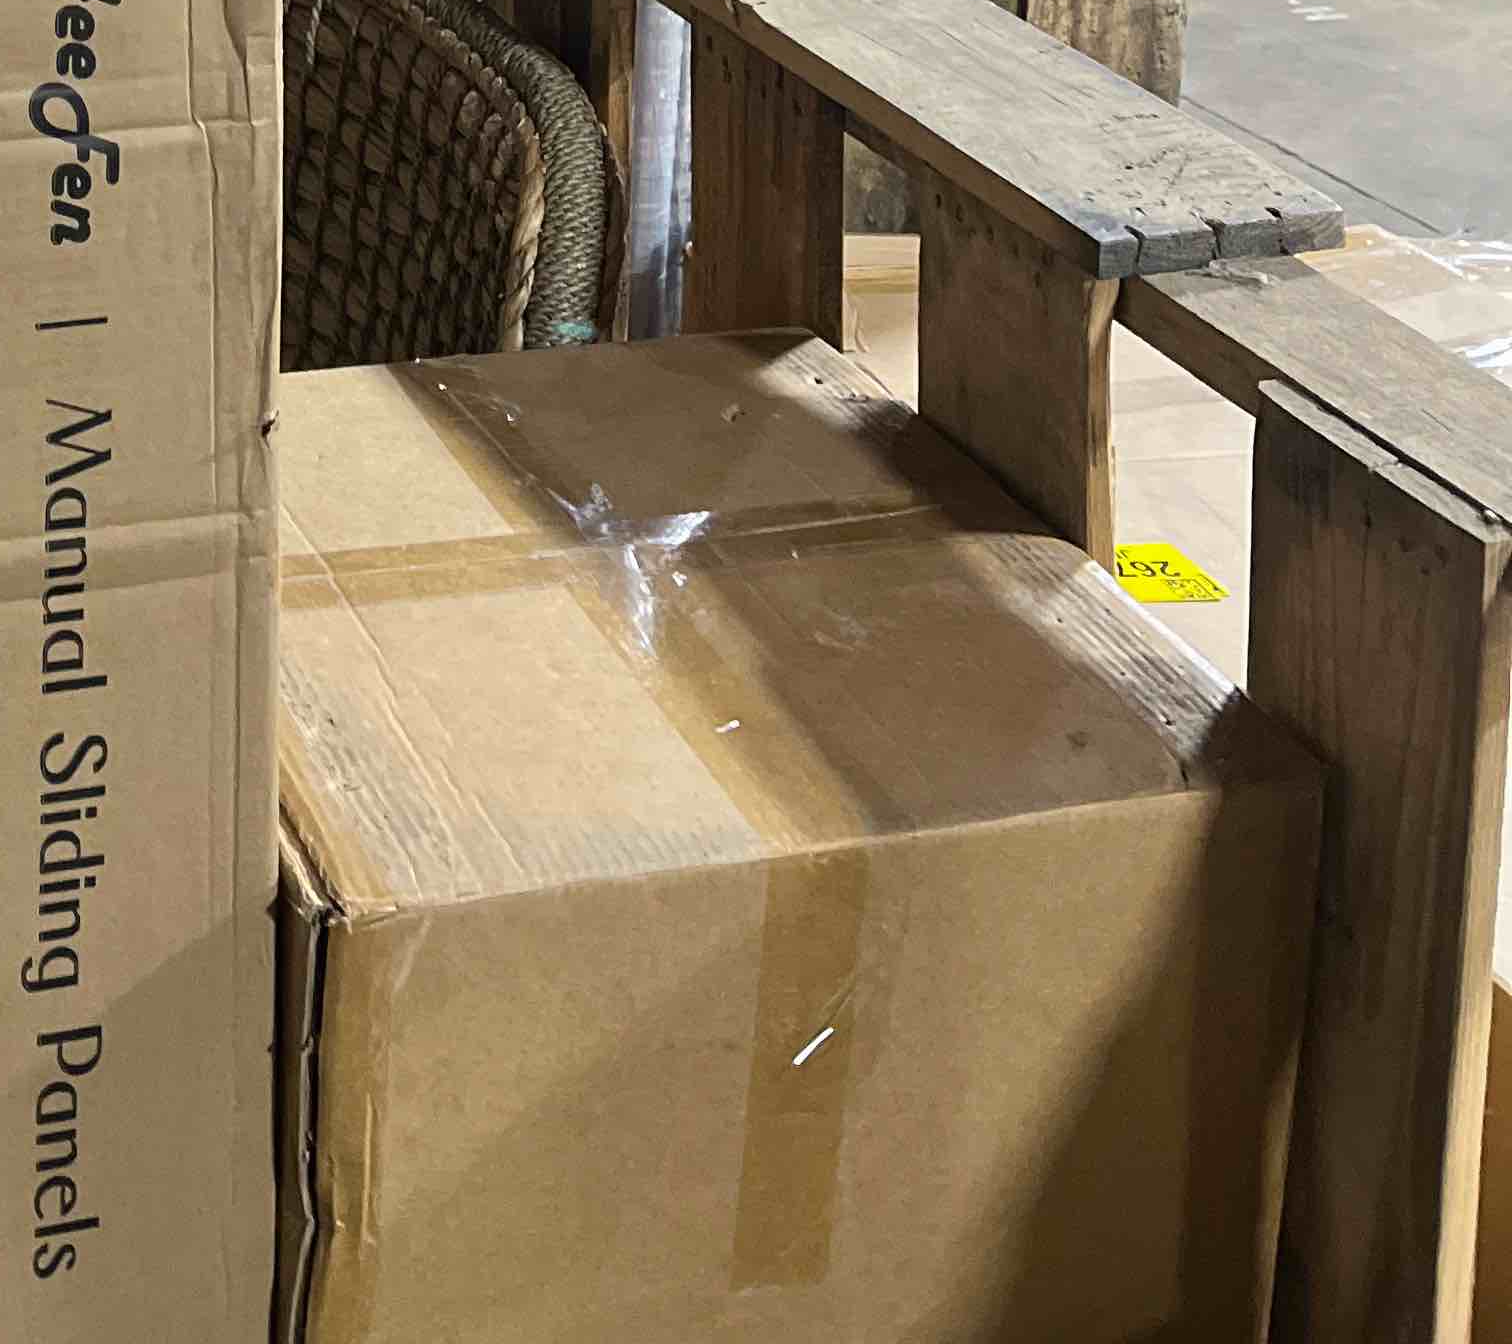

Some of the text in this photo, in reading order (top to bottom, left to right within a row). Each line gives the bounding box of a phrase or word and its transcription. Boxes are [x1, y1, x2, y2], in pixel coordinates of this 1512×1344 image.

[41, 399, 113, 696] Manual
[21, 731, 109, 993] Sliding
[32, 1025, 103, 1281] Panels
